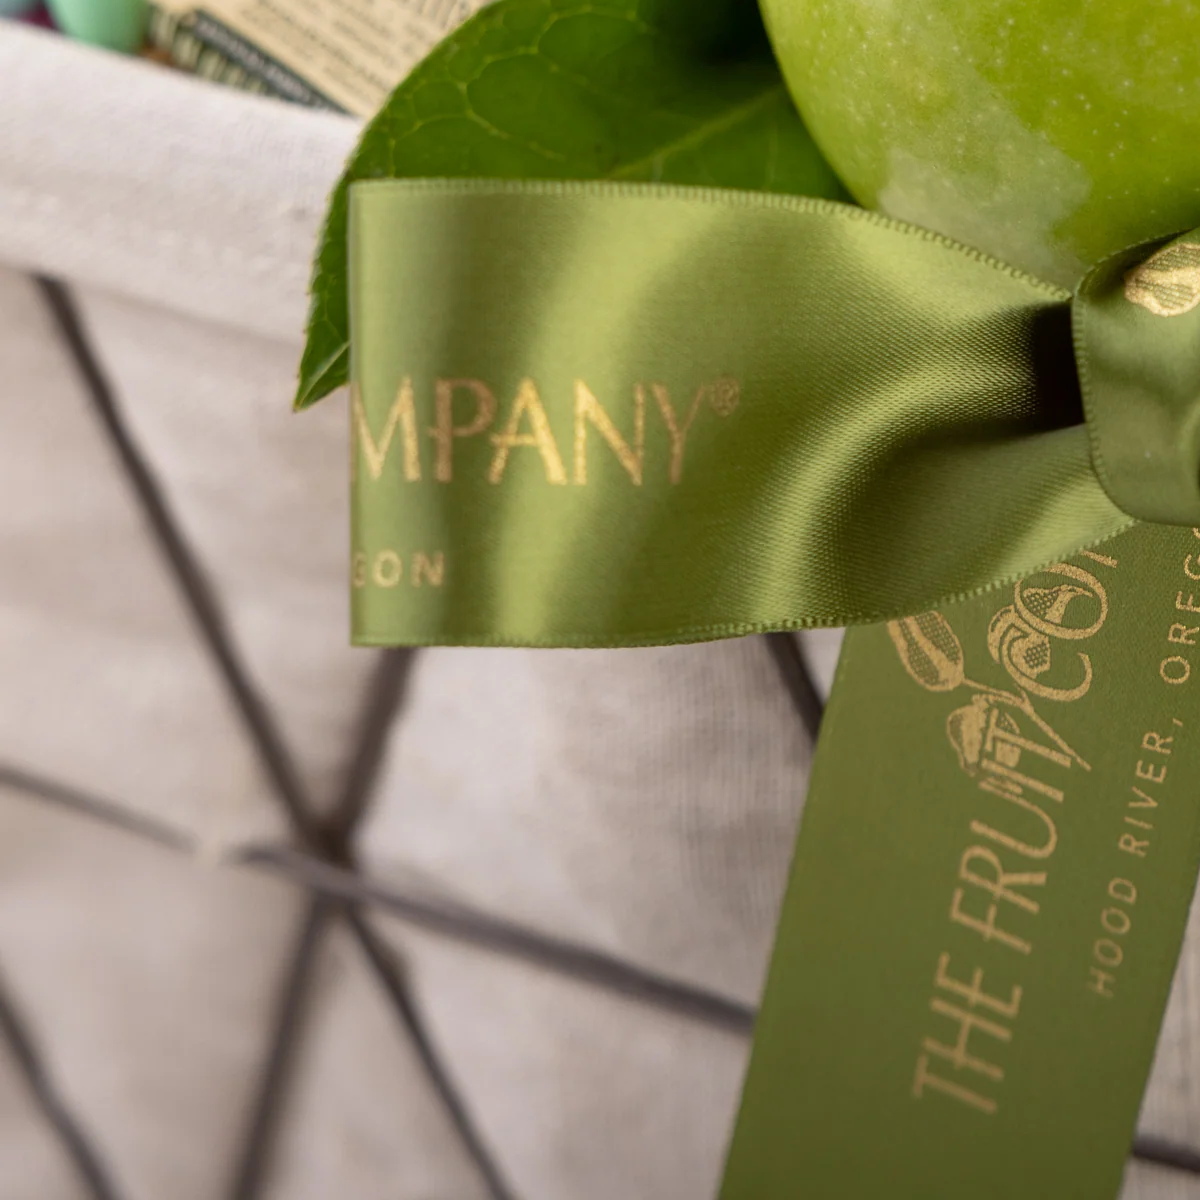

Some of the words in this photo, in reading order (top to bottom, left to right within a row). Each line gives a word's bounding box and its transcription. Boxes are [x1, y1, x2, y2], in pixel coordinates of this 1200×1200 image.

[948, 708, 1073, 955] FRUIT
[1088, 876, 1137, 997] HOOD
[1118, 718, 1185, 856] RIVER,
[911, 953, 1024, 1115] THE
